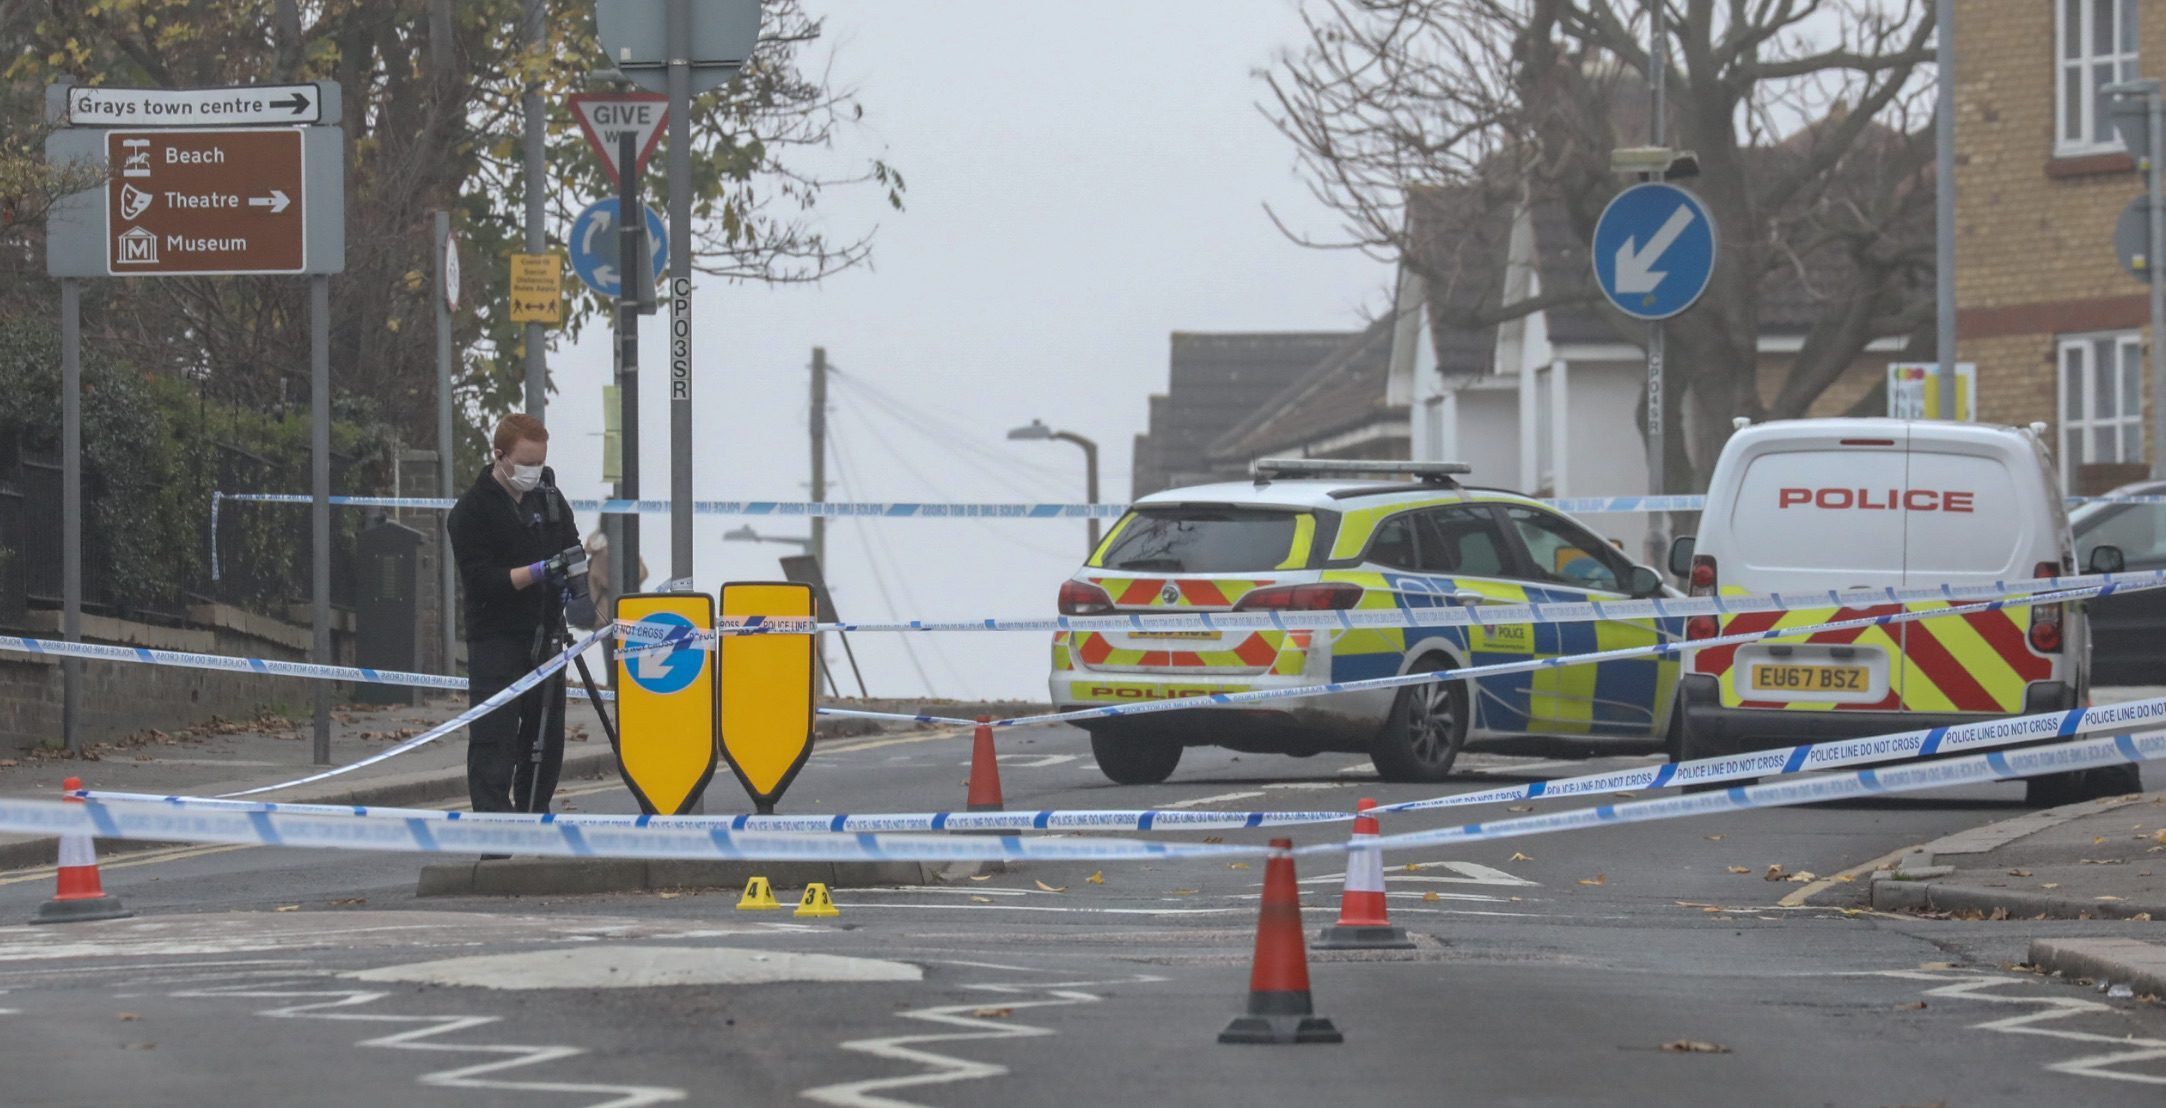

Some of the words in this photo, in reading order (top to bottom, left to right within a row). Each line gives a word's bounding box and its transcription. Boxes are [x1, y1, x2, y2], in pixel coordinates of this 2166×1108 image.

[78, 96, 136, 117] Grays
[143, 99, 193, 114] town
[200, 98, 262, 114] centre
[593, 105, 651, 125] GIVE
[165, 146, 225, 164] Beach
[164, 191, 240, 209] Theatre
[166, 234, 247, 251] Museum
[1779, 488, 1974, 513] POLICE
[620, 624, 636, 635] NOT
[637, 626, 664, 640] CROSS
[1760, 667, 1814, 687] EU67
[1820, 669, 1860, 688] BSZ
[1091, 687, 1234, 699] POLIC
[2085, 709, 2115, 725] POLICE
[2116, 707, 2136, 721] LINE
[2137, 704, 2150, 718] DO
[1946, 728, 1975, 744] POLICE
[1977, 726, 1995, 740] LINE
[1997, 724, 2009, 738] DO
[2011, 721, 2028, 736] NOT
[2029, 717, 2058, 733] CROSS
[1810, 747, 1839, 763] POLICE
[1840, 744, 1858, 759] LINE
[1860, 742, 1872, 756] DO
[1873, 740, 1890, 754] NOT
[1892, 736, 1920, 751] CROSS
[1677, 765, 1705, 779] POLICE
[1707, 762, 1724, 776] LINE
[1726, 761, 1738, 773] DO
[1739, 758, 1756, 772] NOT
[1757, 754, 1785, 769] CROSS
[1547, 784, 1574, 794] POLICE
[1576, 782, 1593, 791] LINE
[1595, 779, 1607, 789] DO
[1608, 777, 1623, 788] NOT
[1626, 772, 1653, 785] CROSS
[1050, 815, 1073, 825] POLICE
[1074, 815, 1088, 825] LINE
[1089, 815, 1099, 825] DO
[1099, 814, 1113, 824] NOT
[1114, 814, 1137, 824] CROSS
[747, 882, 759, 898] 4
[805, 888, 816, 905] 3
[822, 892, 828, 904] 3
